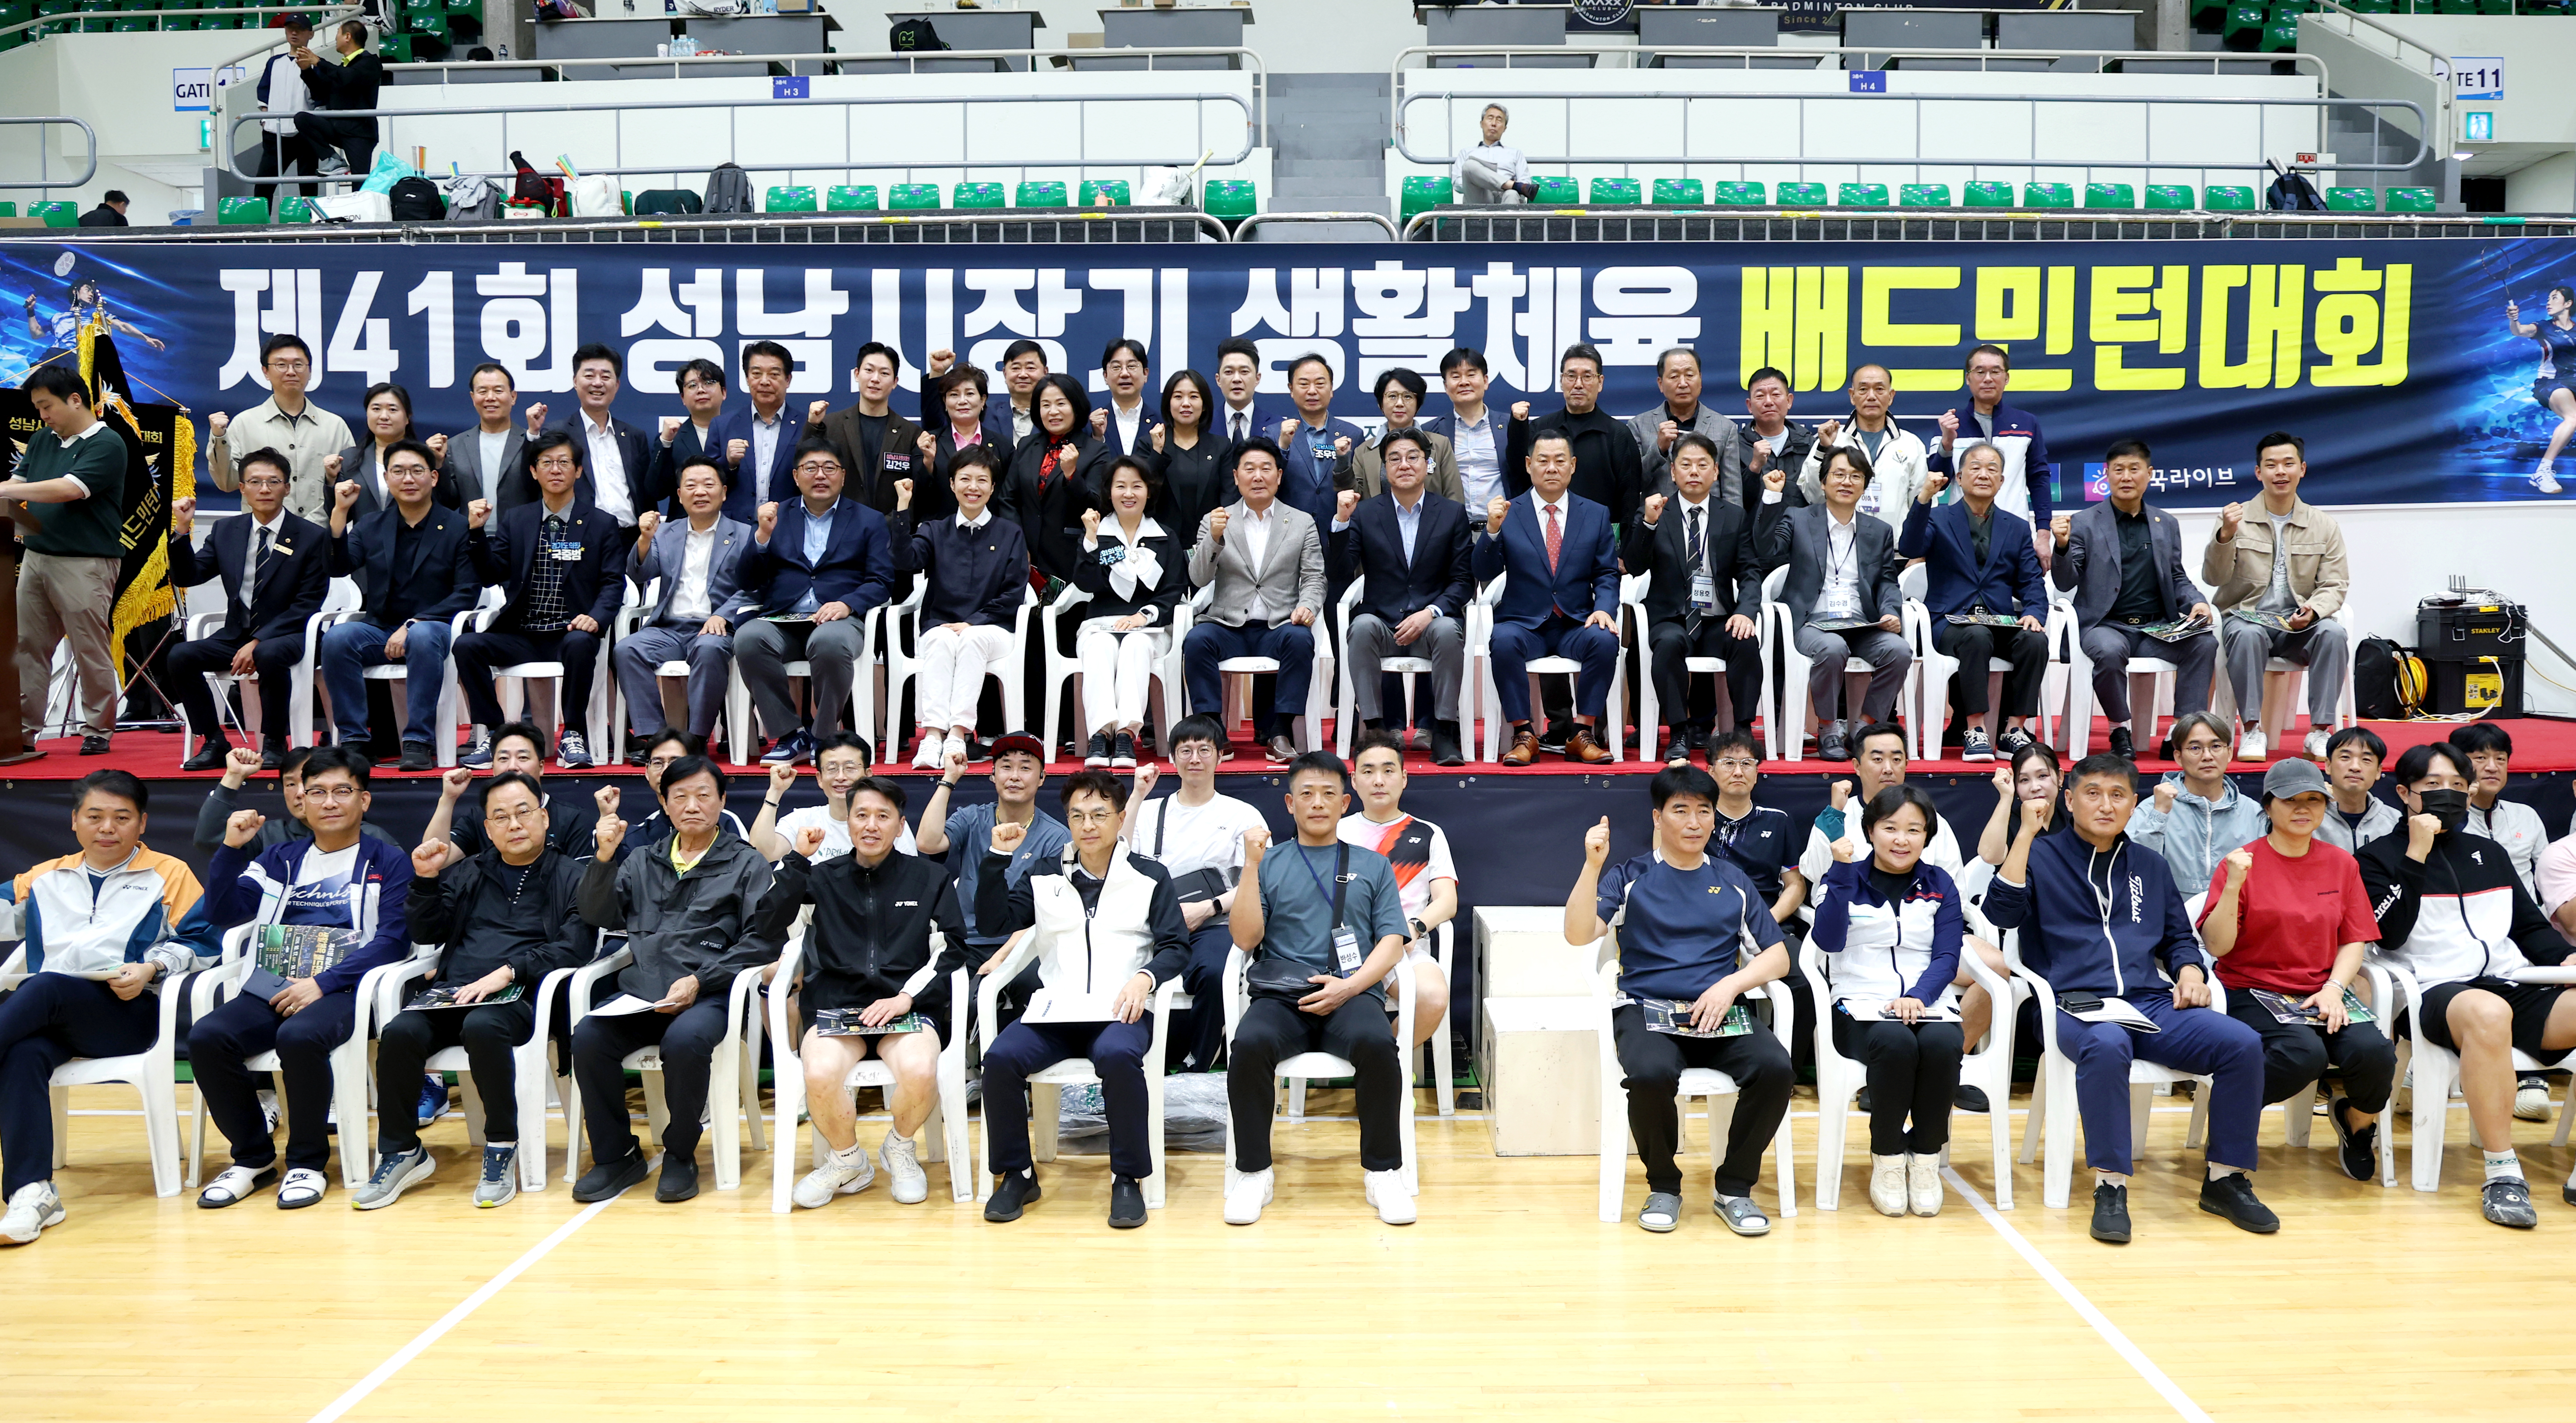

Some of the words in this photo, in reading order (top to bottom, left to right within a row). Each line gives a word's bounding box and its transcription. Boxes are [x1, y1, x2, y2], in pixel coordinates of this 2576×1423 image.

[2477, 69, 2499, 87] 11
[219, 262, 577, 393] 제41회
[1231, 260, 1701, 393] 생활체육
[1741, 258, 2412, 392] 배드민턴대회
[886, 460, 910, 471] 김건우
[552, 549, 581, 561] 국중범
[1100, 545, 1121, 557] 회의원
[2128, 871, 2143, 924] Titleist
[2374, 895, 2395, 922] TRIC
[1340, 952, 1358, 964] 반성수
